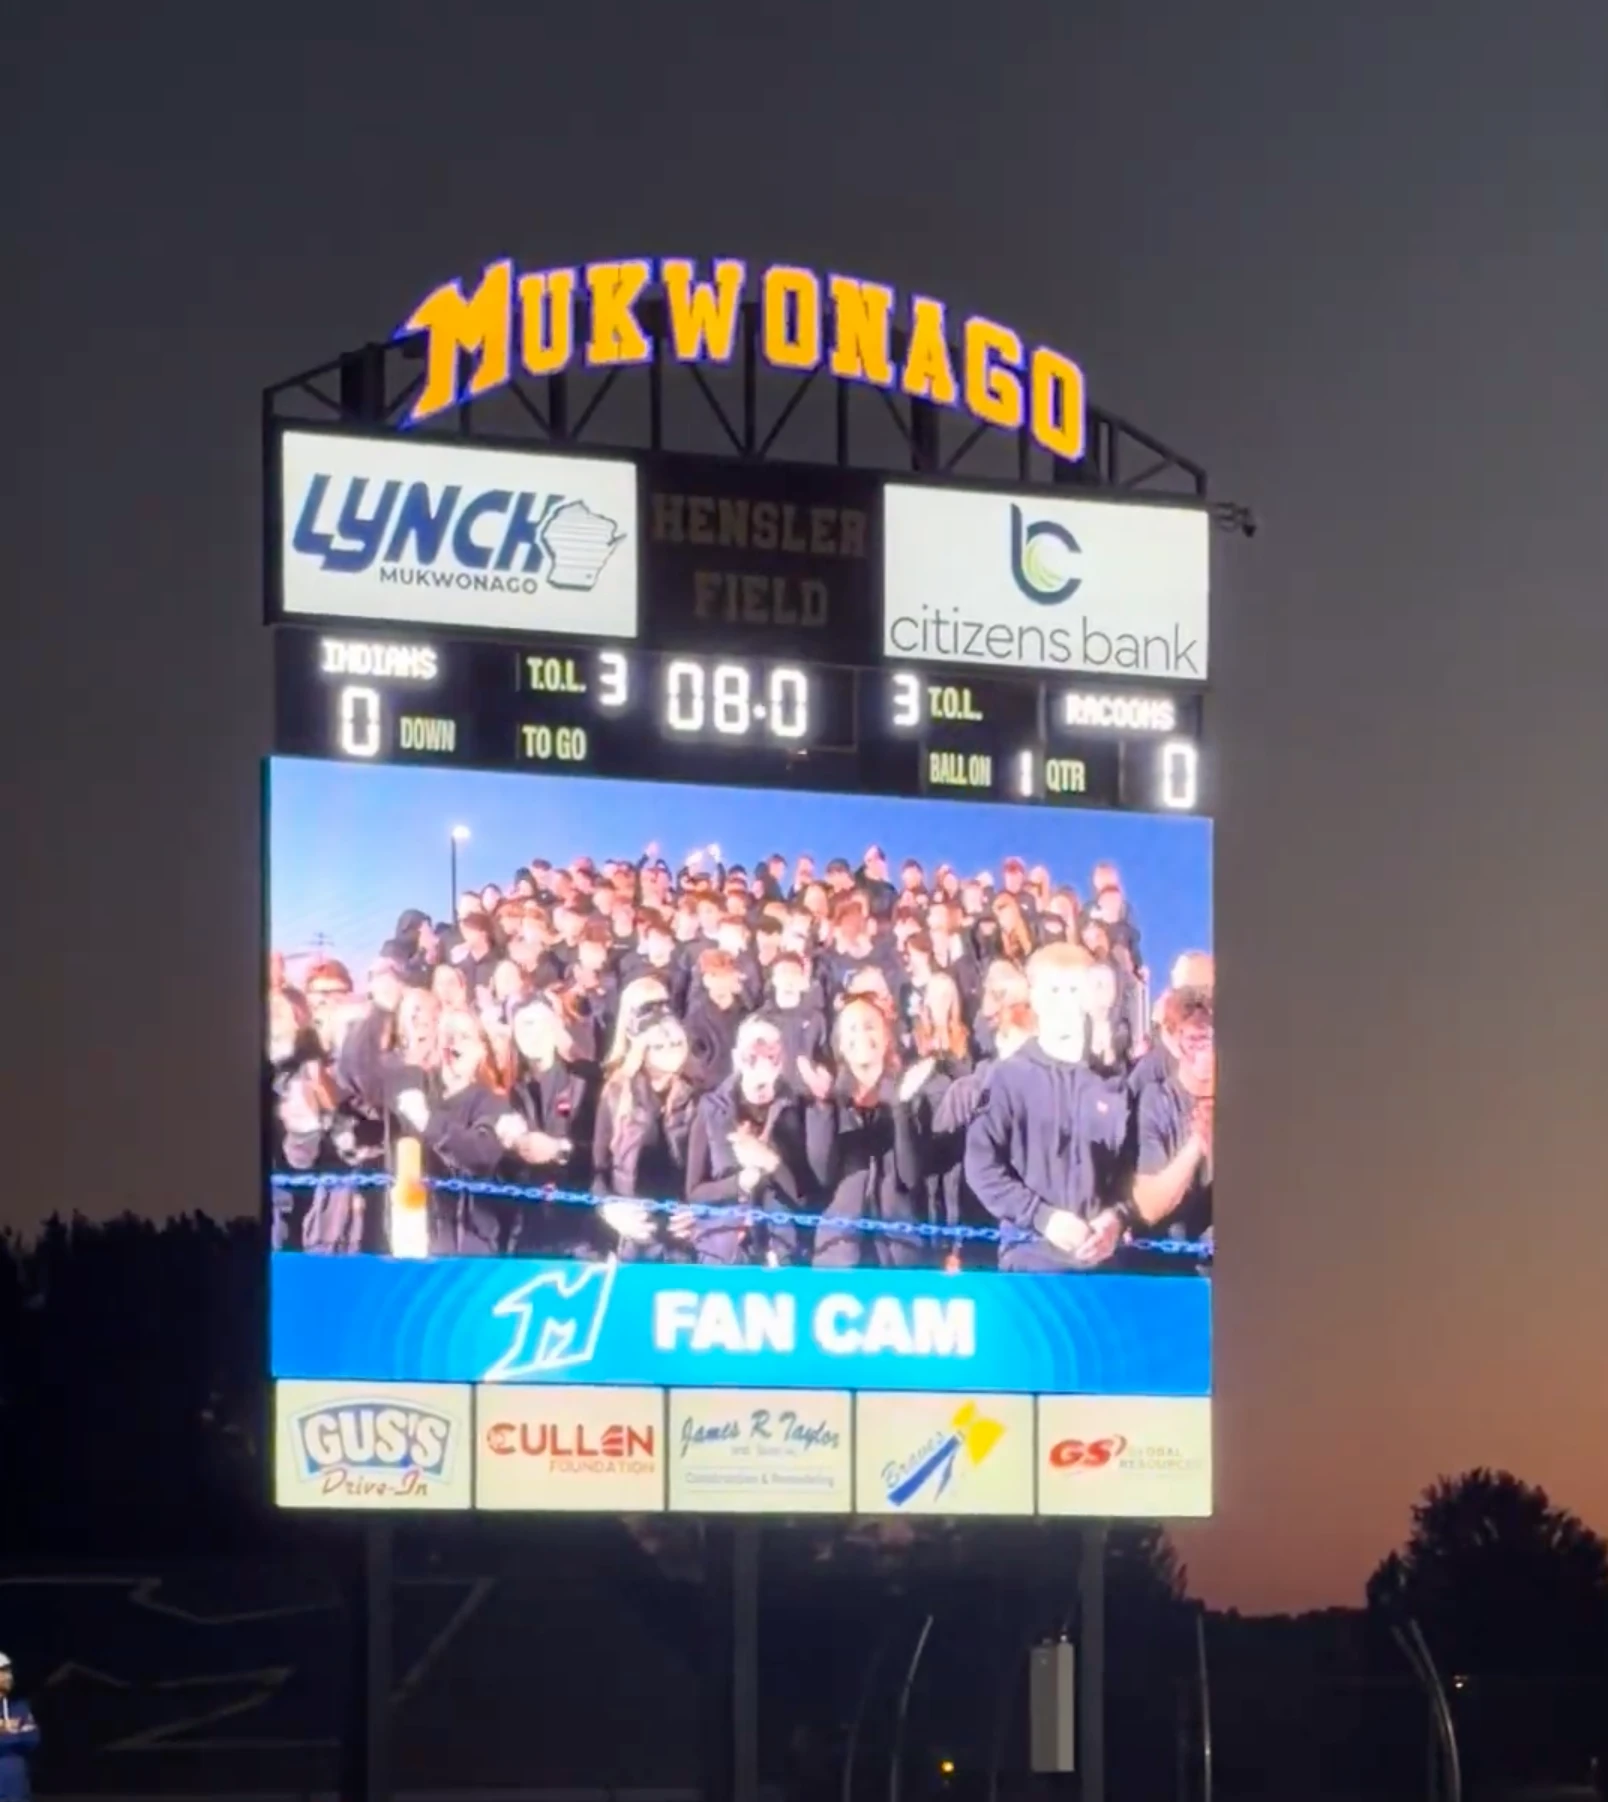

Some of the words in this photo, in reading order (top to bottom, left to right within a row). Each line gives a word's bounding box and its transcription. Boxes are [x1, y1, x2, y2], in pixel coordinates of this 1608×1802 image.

[392, 257, 1086, 461] MUKWONAGO
[293, 473, 565, 574] LYNCH
[653, 493, 867, 558] HENSLER
[379, 567, 538, 594] MUKWONAGO
[693, 571, 829, 626] FIELD
[321, 638, 438, 680] INDIANS
[889, 603, 1072, 666] citizens
[1083, 616, 1199, 673] bank
[526, 657, 587, 692] T.O.L.
[600, 652, 627, 706] 3
[340, 686, 381, 757] 0
[893, 674, 920, 727] 3
[928, 687, 983, 721] T.O.L.
[400, 717, 456, 752] DOWN
[522, 725, 551, 759] TO
[556, 727, 587, 761] GO
[929, 753, 967, 785] BALL
[970, 757, 992, 787] ON
[1019, 750, 1034, 797] 1
[1047, 759, 1086, 792] QTR
[1162, 743, 1198, 809] 0
[653, 1289, 795, 1352] FAN
[813, 1294, 975, 1357] CAM
[303, 1408, 450, 1469] GUS'S
[486, 1422, 655, 1458] CULLEN
[680, 1416, 741, 1459] James
[750, 1409, 772, 1439] R
[779, 1411, 840, 1450] Taylor
[321, 1468, 428, 1497] Drive-In
[549, 1460, 655, 1475] FOUNDATION
